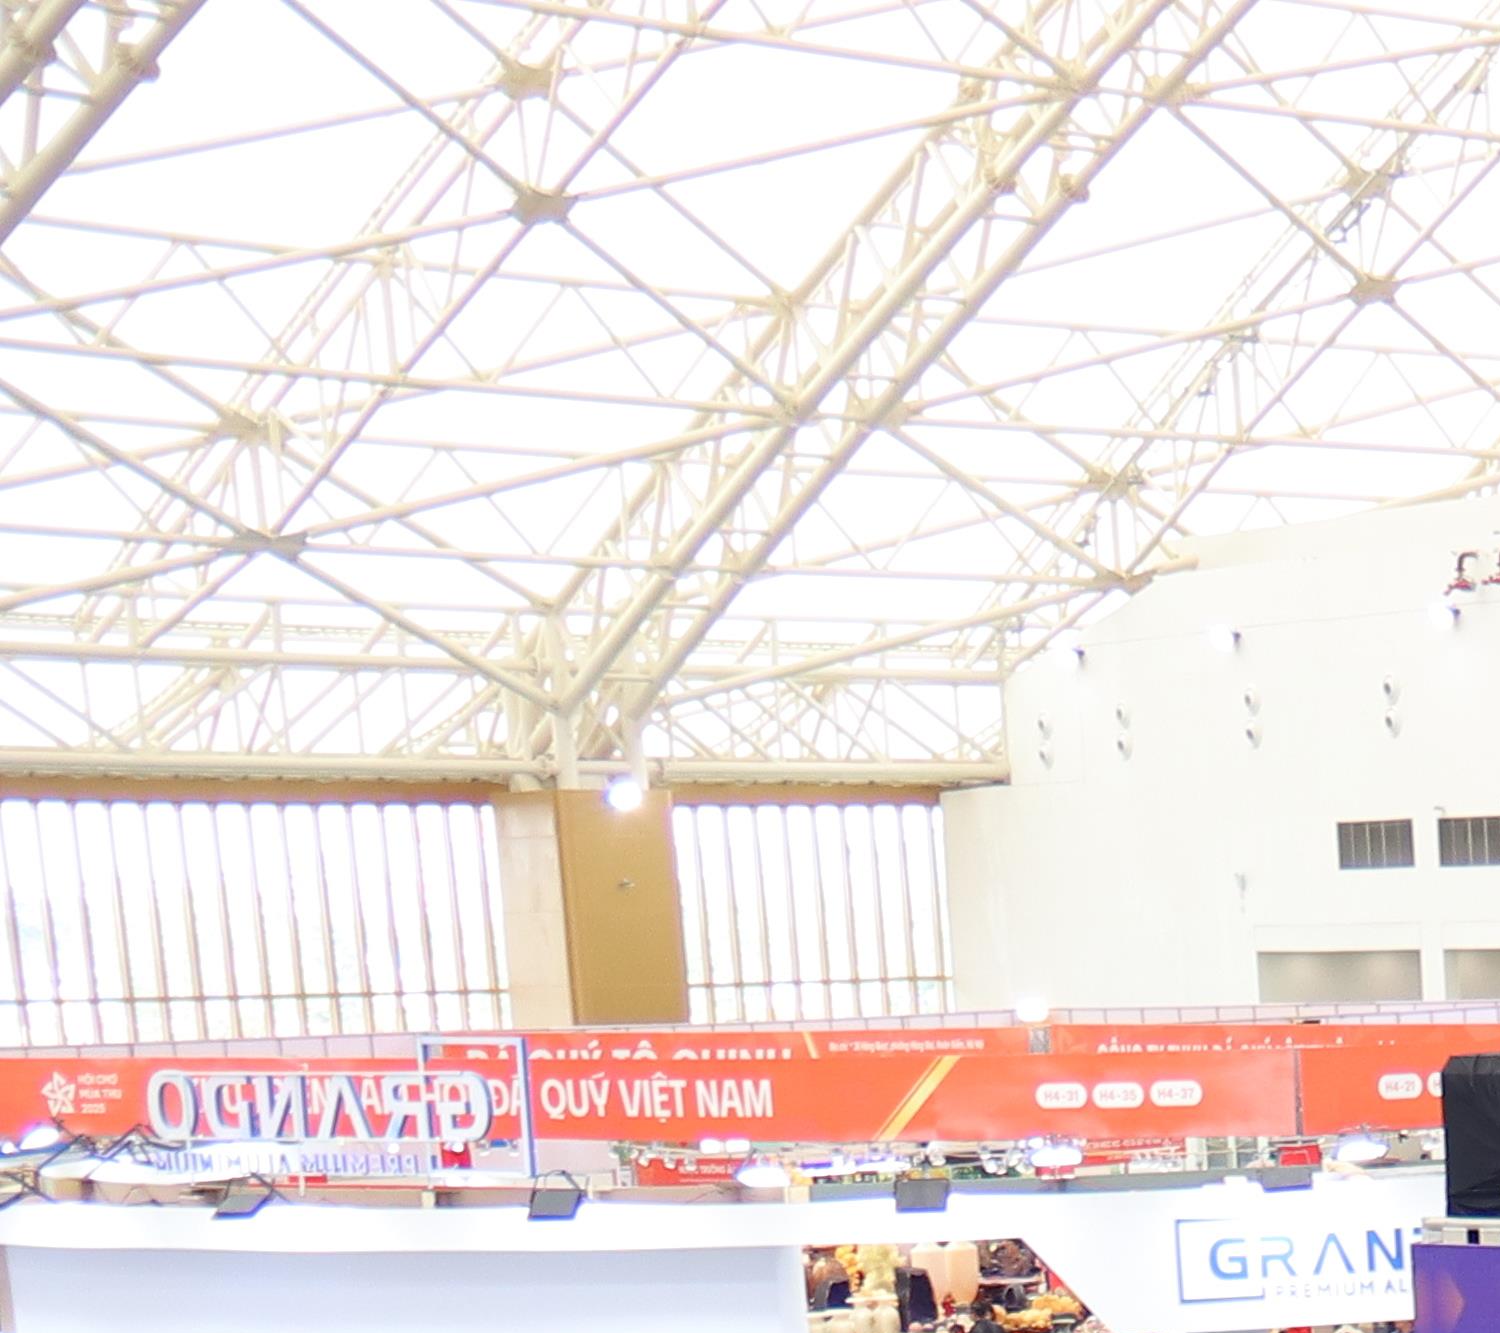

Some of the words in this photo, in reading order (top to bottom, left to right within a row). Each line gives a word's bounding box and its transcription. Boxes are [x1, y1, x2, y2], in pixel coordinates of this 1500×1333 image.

[541, 1071, 611, 1122] QUÝ
[613, 1074, 683, 1125] VIỆT
[685, 1078, 775, 1119] NAM
[1207, 1228, 1421, 1281] GRAN
